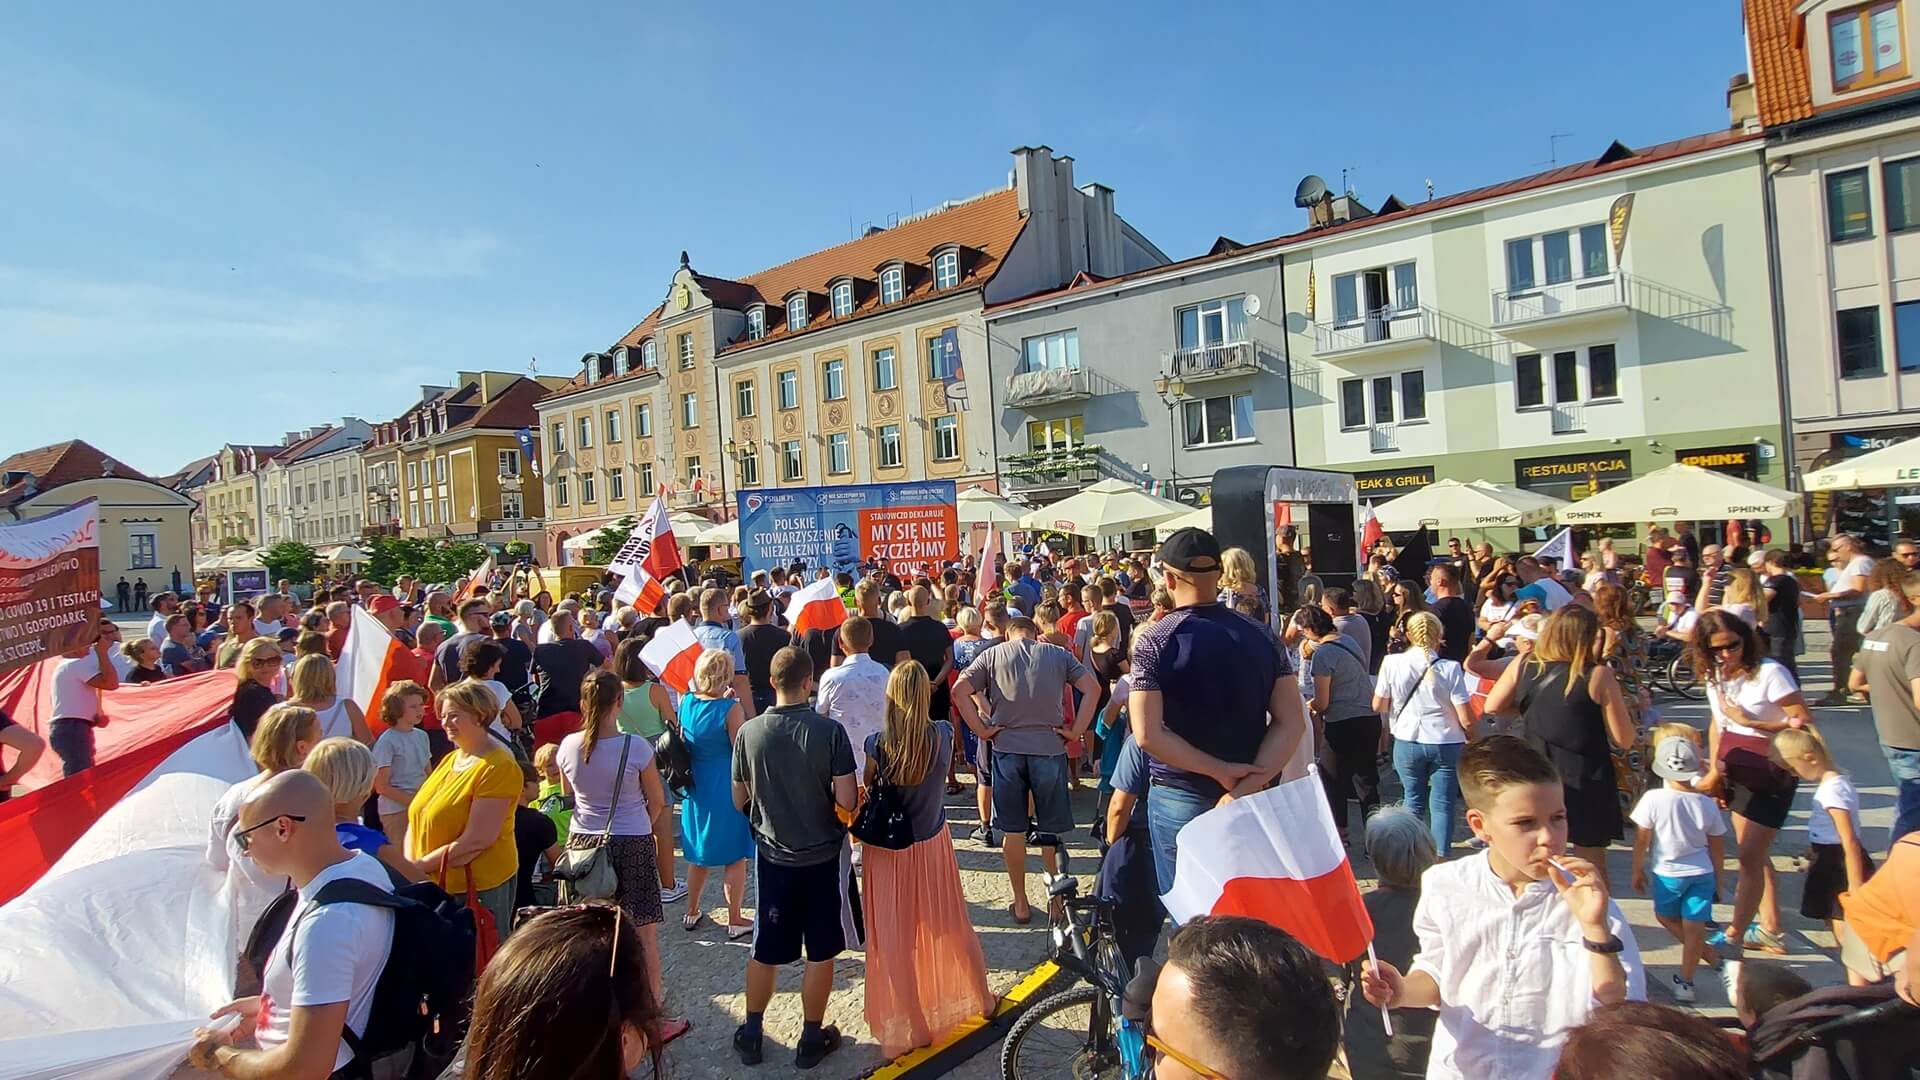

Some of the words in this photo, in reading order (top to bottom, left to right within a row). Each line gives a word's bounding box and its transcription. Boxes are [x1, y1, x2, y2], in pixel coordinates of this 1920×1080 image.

[1861, 438, 1891, 449] sky
[1682, 453, 1746, 466] SPHINX
[1522, 459, 1626, 477] RESTAURACJA
[1385, 477, 1393, 487] &
[1395, 474, 1430, 487] GRILL
[870, 512, 908, 521] STANOWCZO
[909, 509, 944, 519] DEKLARUJE
[1727, 506, 1770, 514] SPHINX
[774, 517, 815, 530] POLSKIE
[754, 529, 840, 545] STOWARZYSZENIE
[871, 525, 892, 541] MY
[896, 523, 918, 543] SIĘ
[921, 521, 945, 538] NIE
[872, 541, 946, 560] SZCZEPIMY
[6, 601, 34, 619] COVID
[36, 599, 49, 612] 19
[50, 597, 55, 610] I
[57, 590, 98, 608] TESTACH
[19, 623, 25, 636] I
[26, 609, 88, 634] GOSPODARKĘ
